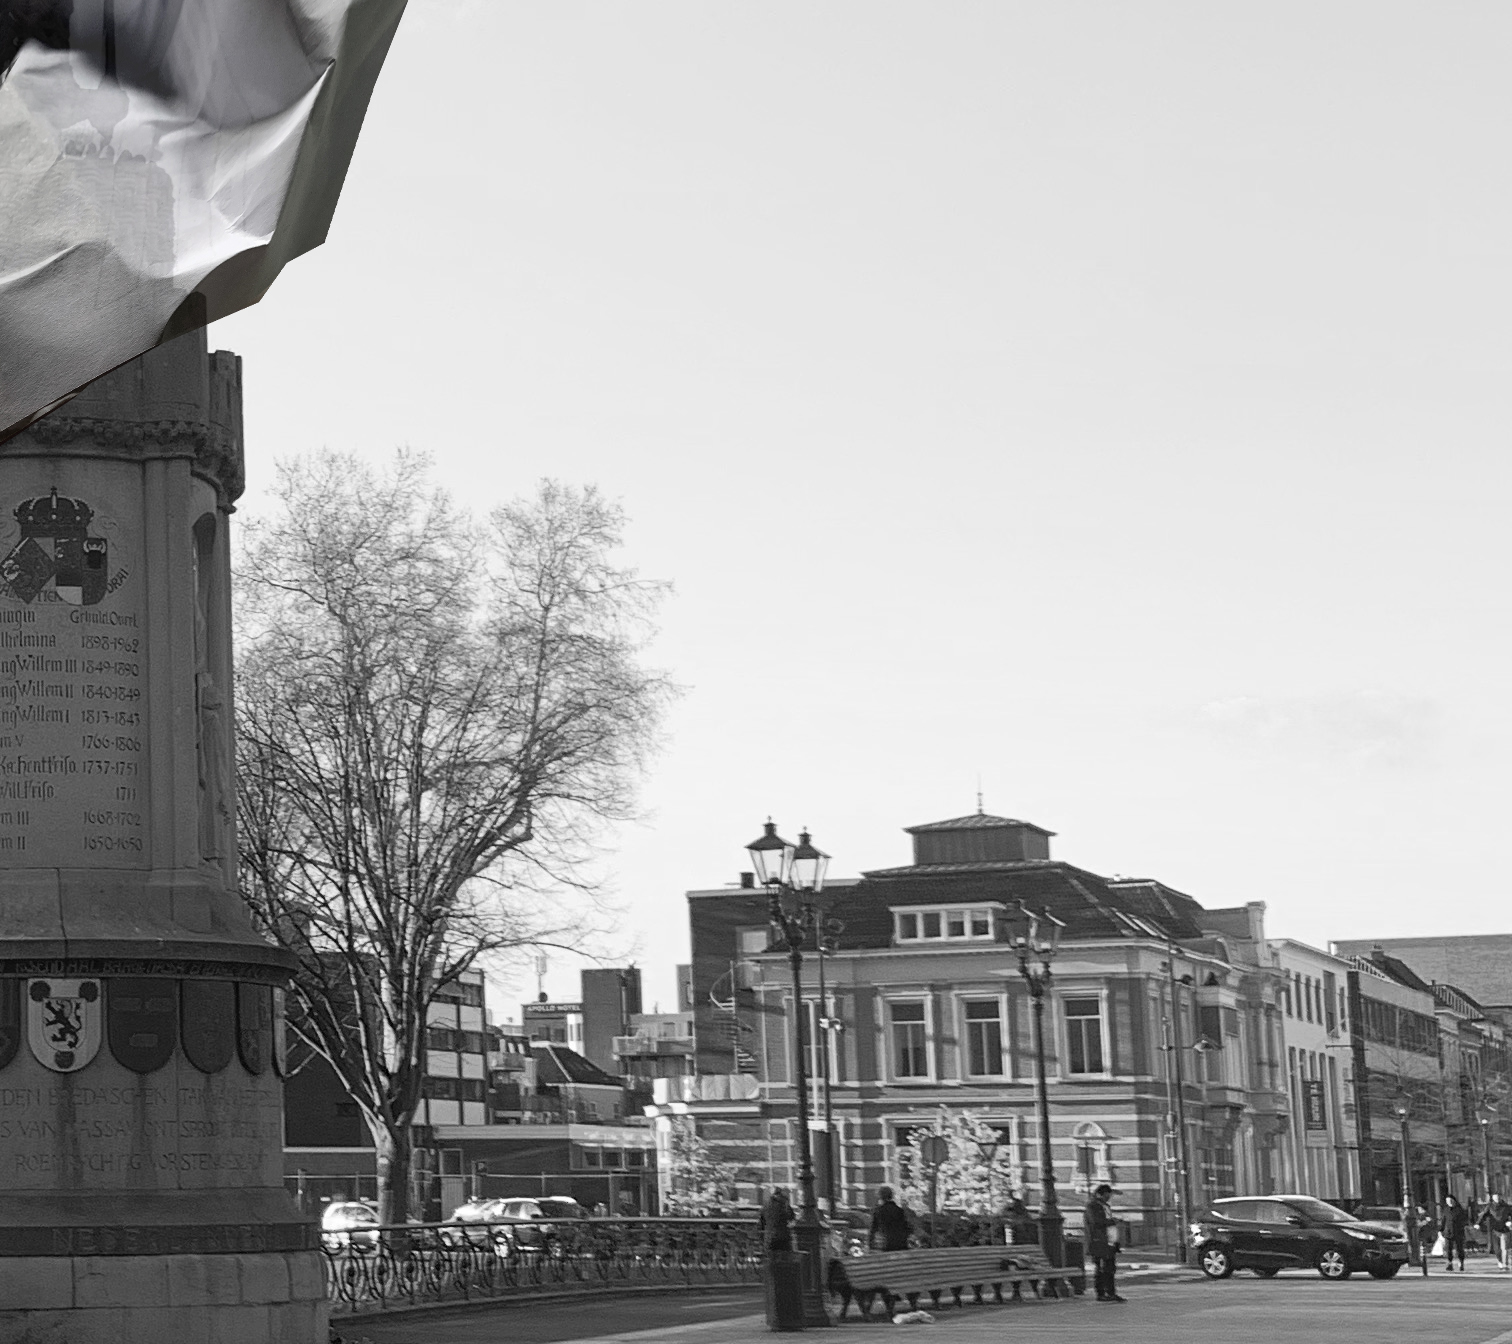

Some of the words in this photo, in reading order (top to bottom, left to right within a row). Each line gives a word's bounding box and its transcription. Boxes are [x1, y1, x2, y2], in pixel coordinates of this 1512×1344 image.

[81, 635, 139, 654] 1898-1962
[15, 654, 63, 673] Willem
[65, 659, 78, 674] III
[81, 660, 139, 677] 1849-1890
[15, 679, 63, 699] Willem
[65, 683, 74, 699] II
[82, 683, 141, 702] 1840-1849
[15, 705, 64, 723] Willem
[14, 734, 25, 748] V
[82, 734, 142, 752] 1766-1806
[82, 760, 138, 776] 1737-1751
[115, 786, 137, 801] 1711
[17, 810, 30, 825] III
[17, 836, 26, 851] II
